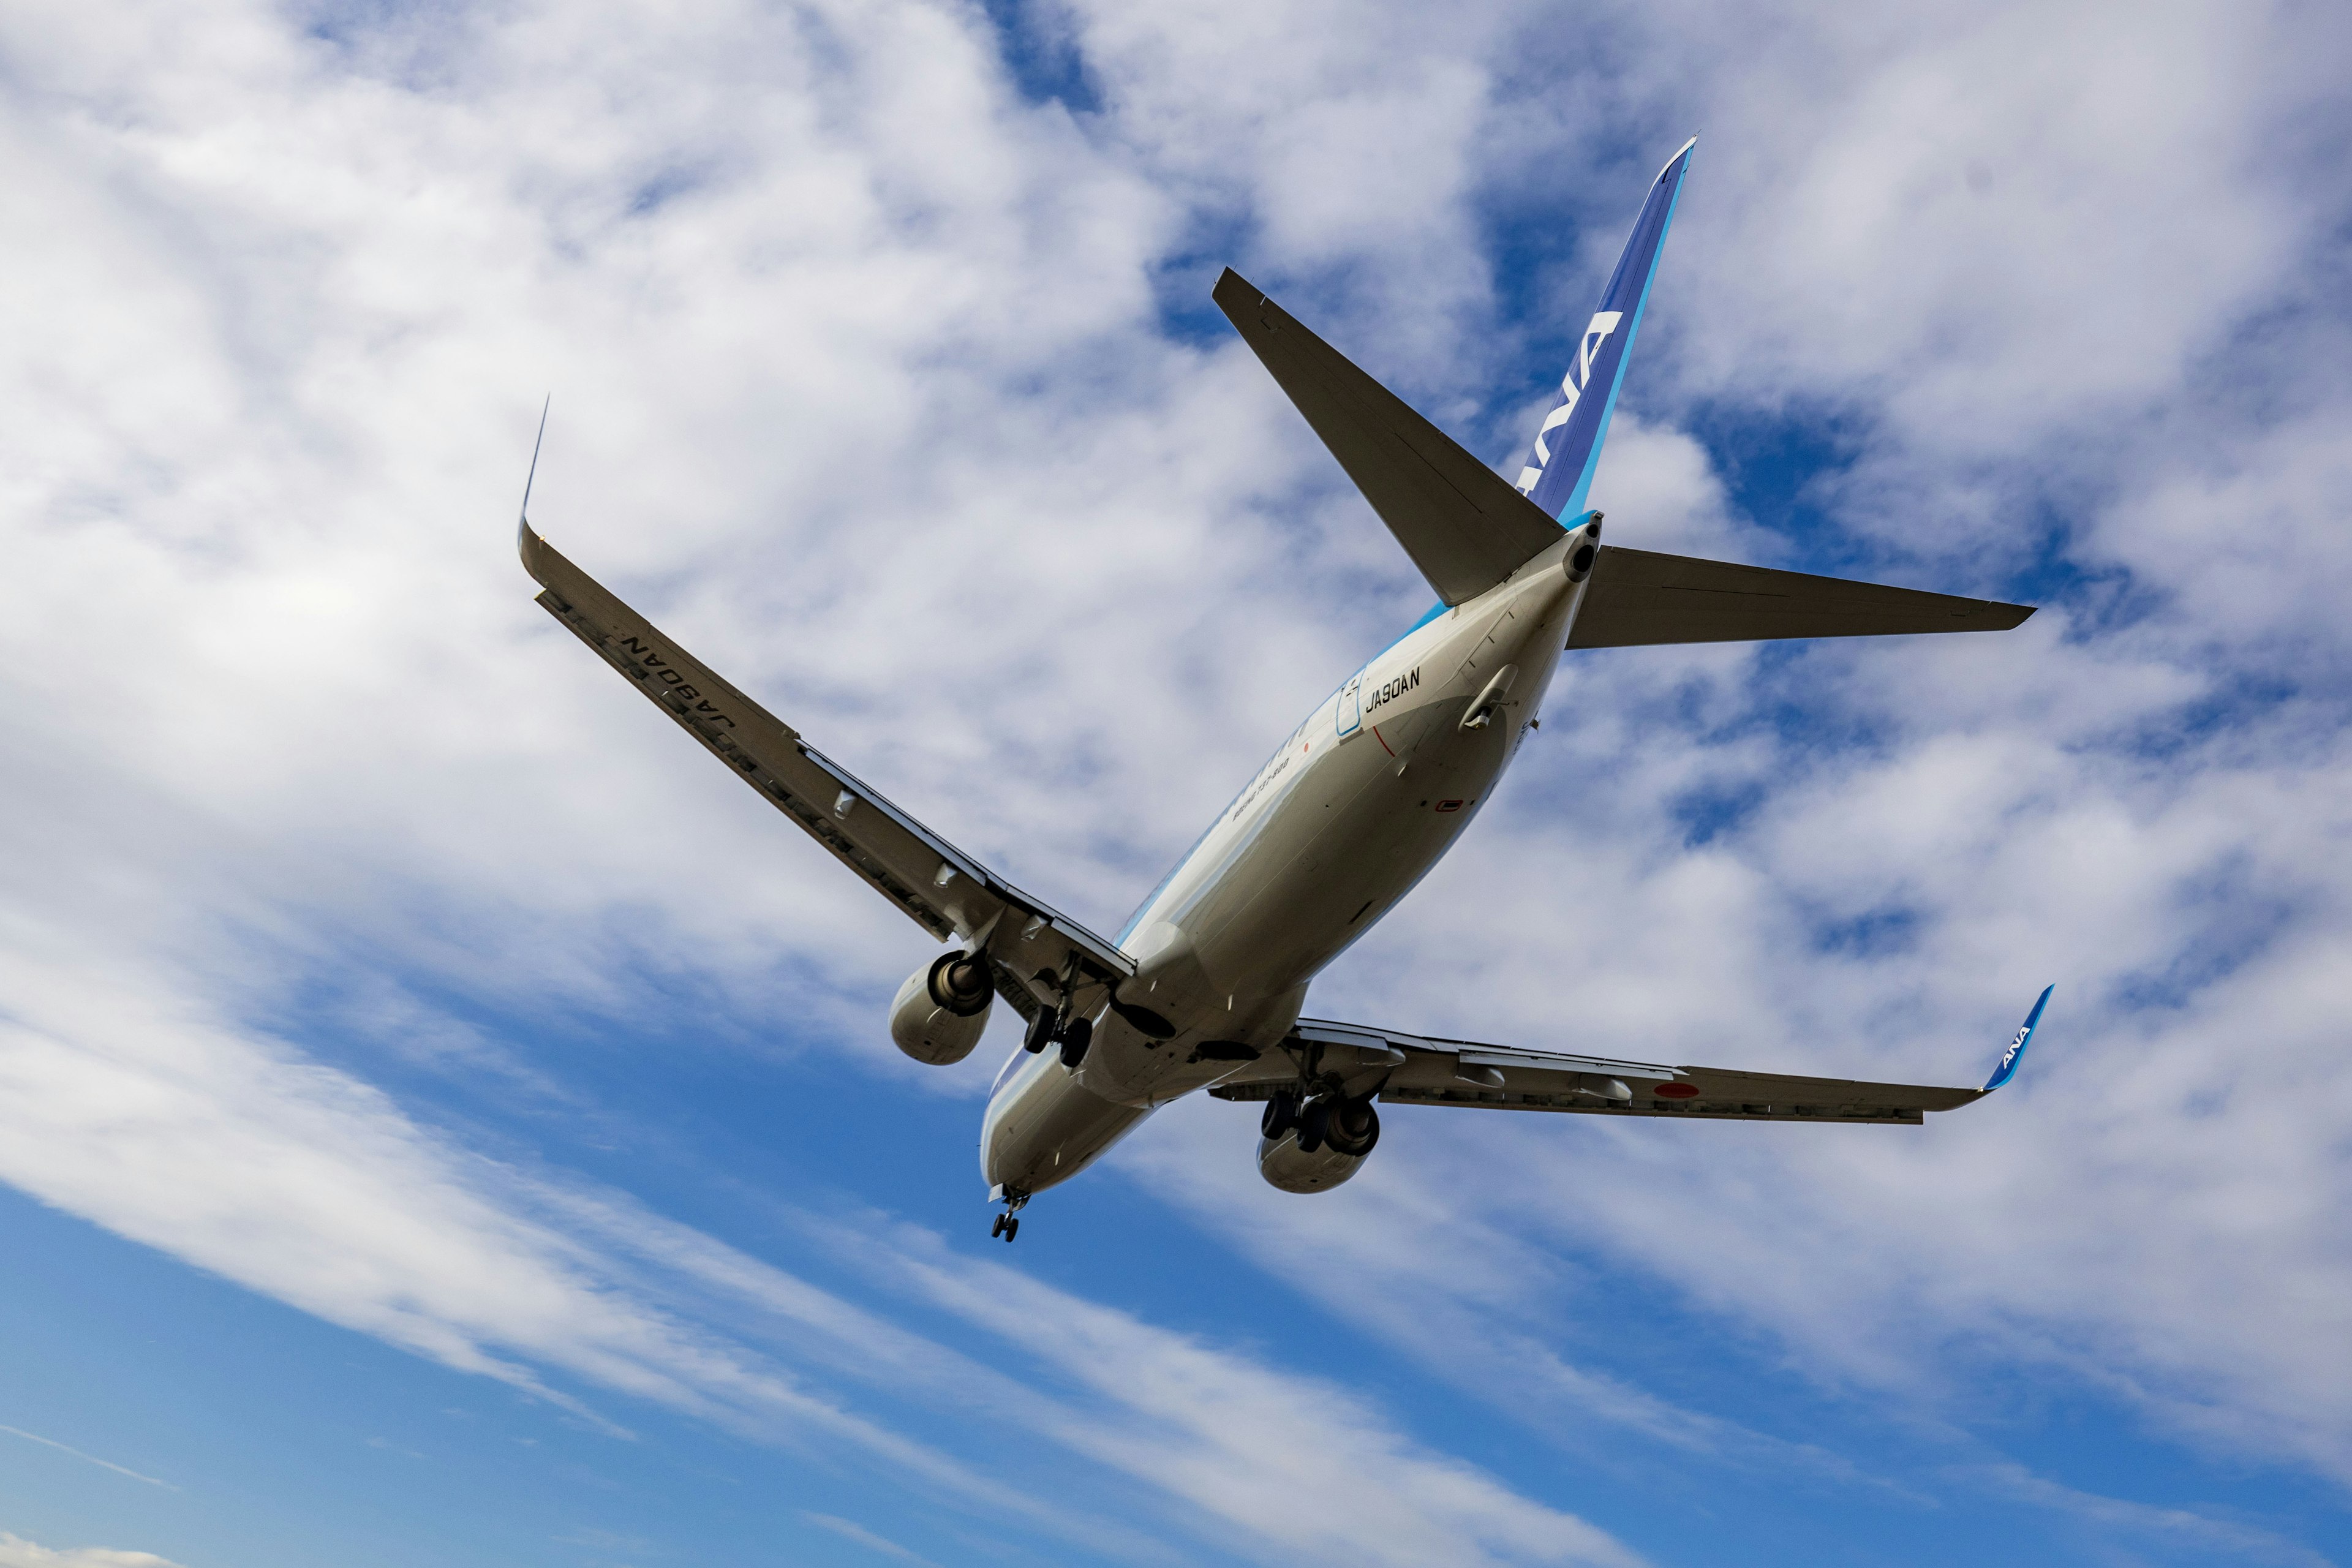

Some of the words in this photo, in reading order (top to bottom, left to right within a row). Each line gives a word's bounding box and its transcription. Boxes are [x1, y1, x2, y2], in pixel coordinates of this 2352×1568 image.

[620, 636, 736, 728] JA90AN
[1366, 666, 1420, 714] JA90AN
[1257, 757, 1289, 795] 737-800
[2003, 1027, 2030, 1069] ANA
